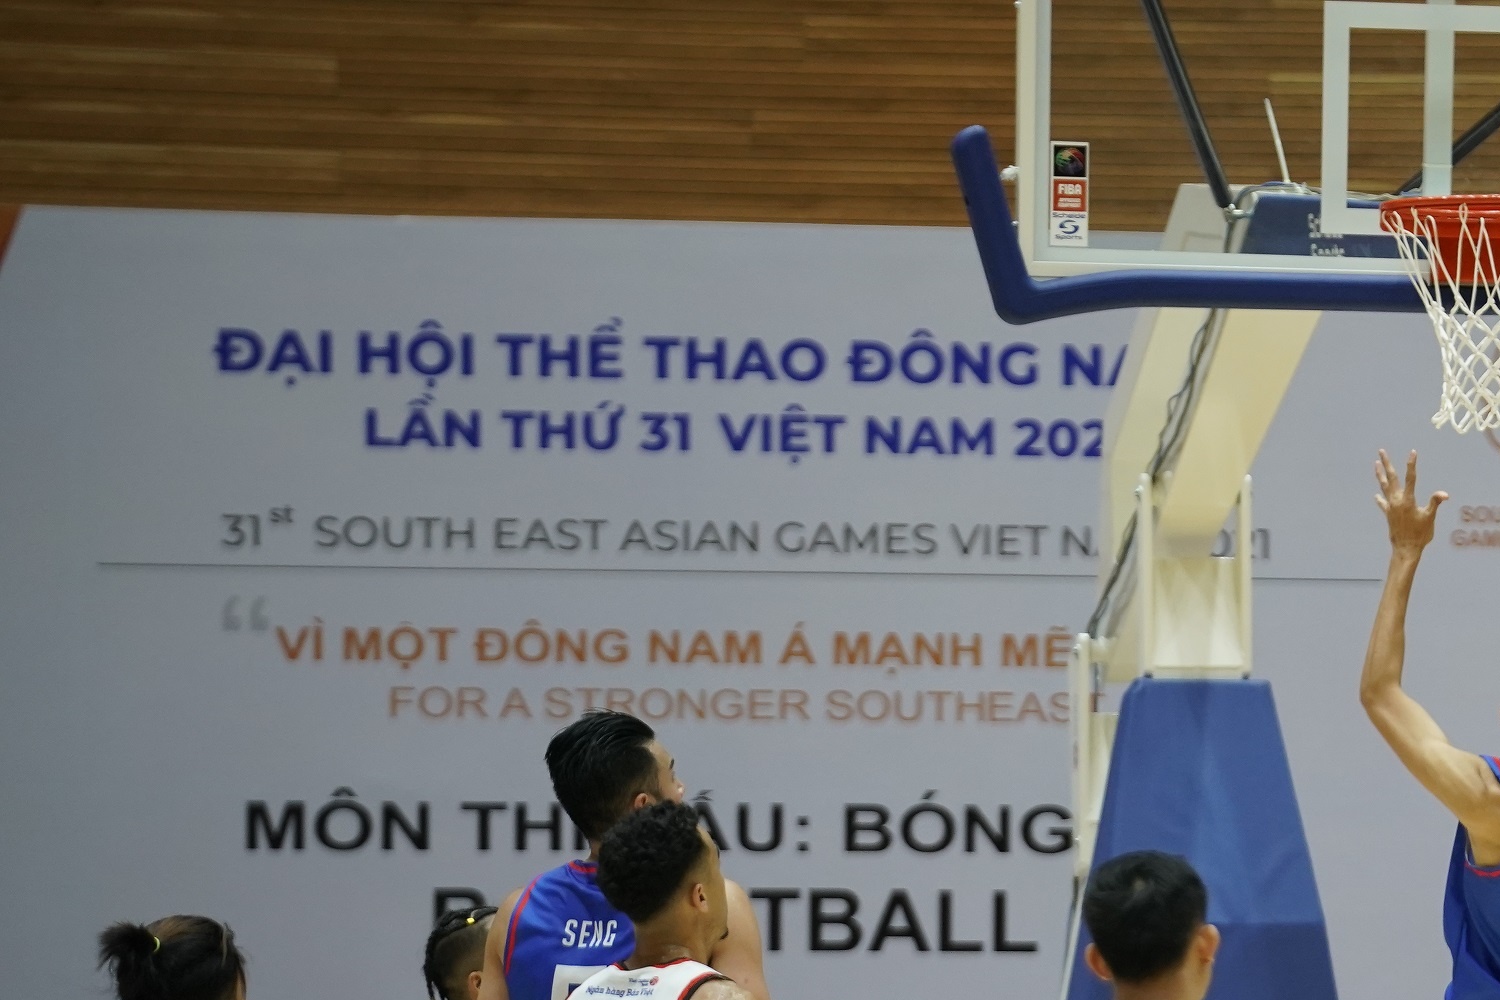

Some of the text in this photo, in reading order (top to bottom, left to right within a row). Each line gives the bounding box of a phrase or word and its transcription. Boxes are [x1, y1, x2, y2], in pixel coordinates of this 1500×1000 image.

[1058, 183, 1082, 195] FIBA
[214, 328, 332, 387] ĐẠI
[358, 320, 474, 388] HỘI
[498, 316, 624, 379] THỂ
[645, 336, 827, 383] THAO
[848, 329, 1039, 386] ĐÔNG
[365, 392, 1104, 464] LẦN THỨ 31 VIỆT NAM 202
[315, 516, 475, 551] SOUTH
[494, 518, 607, 551] EAST
[620, 520, 758, 553] ASIAN
[775, 521, 937, 556] GAMES
[950, 523, 1047, 557] VIET
[277, 617, 325, 662] VÌ
[345, 619, 459, 670] MỘT
[475, 619, 629, 664] ĐÔNG
[648, 629, 762, 665] NAM
[780, 620, 816, 666] Á
[833, 631, 983, 675] MẠNH
[389, 686, 488, 719] FOR
[500, 688, 534, 719] A
[545, 687, 812, 723] STRONGER
[246, 786, 430, 850] MÔN
[845, 789, 1074, 853] BÓNG
[562, 918, 618, 948] SENG
